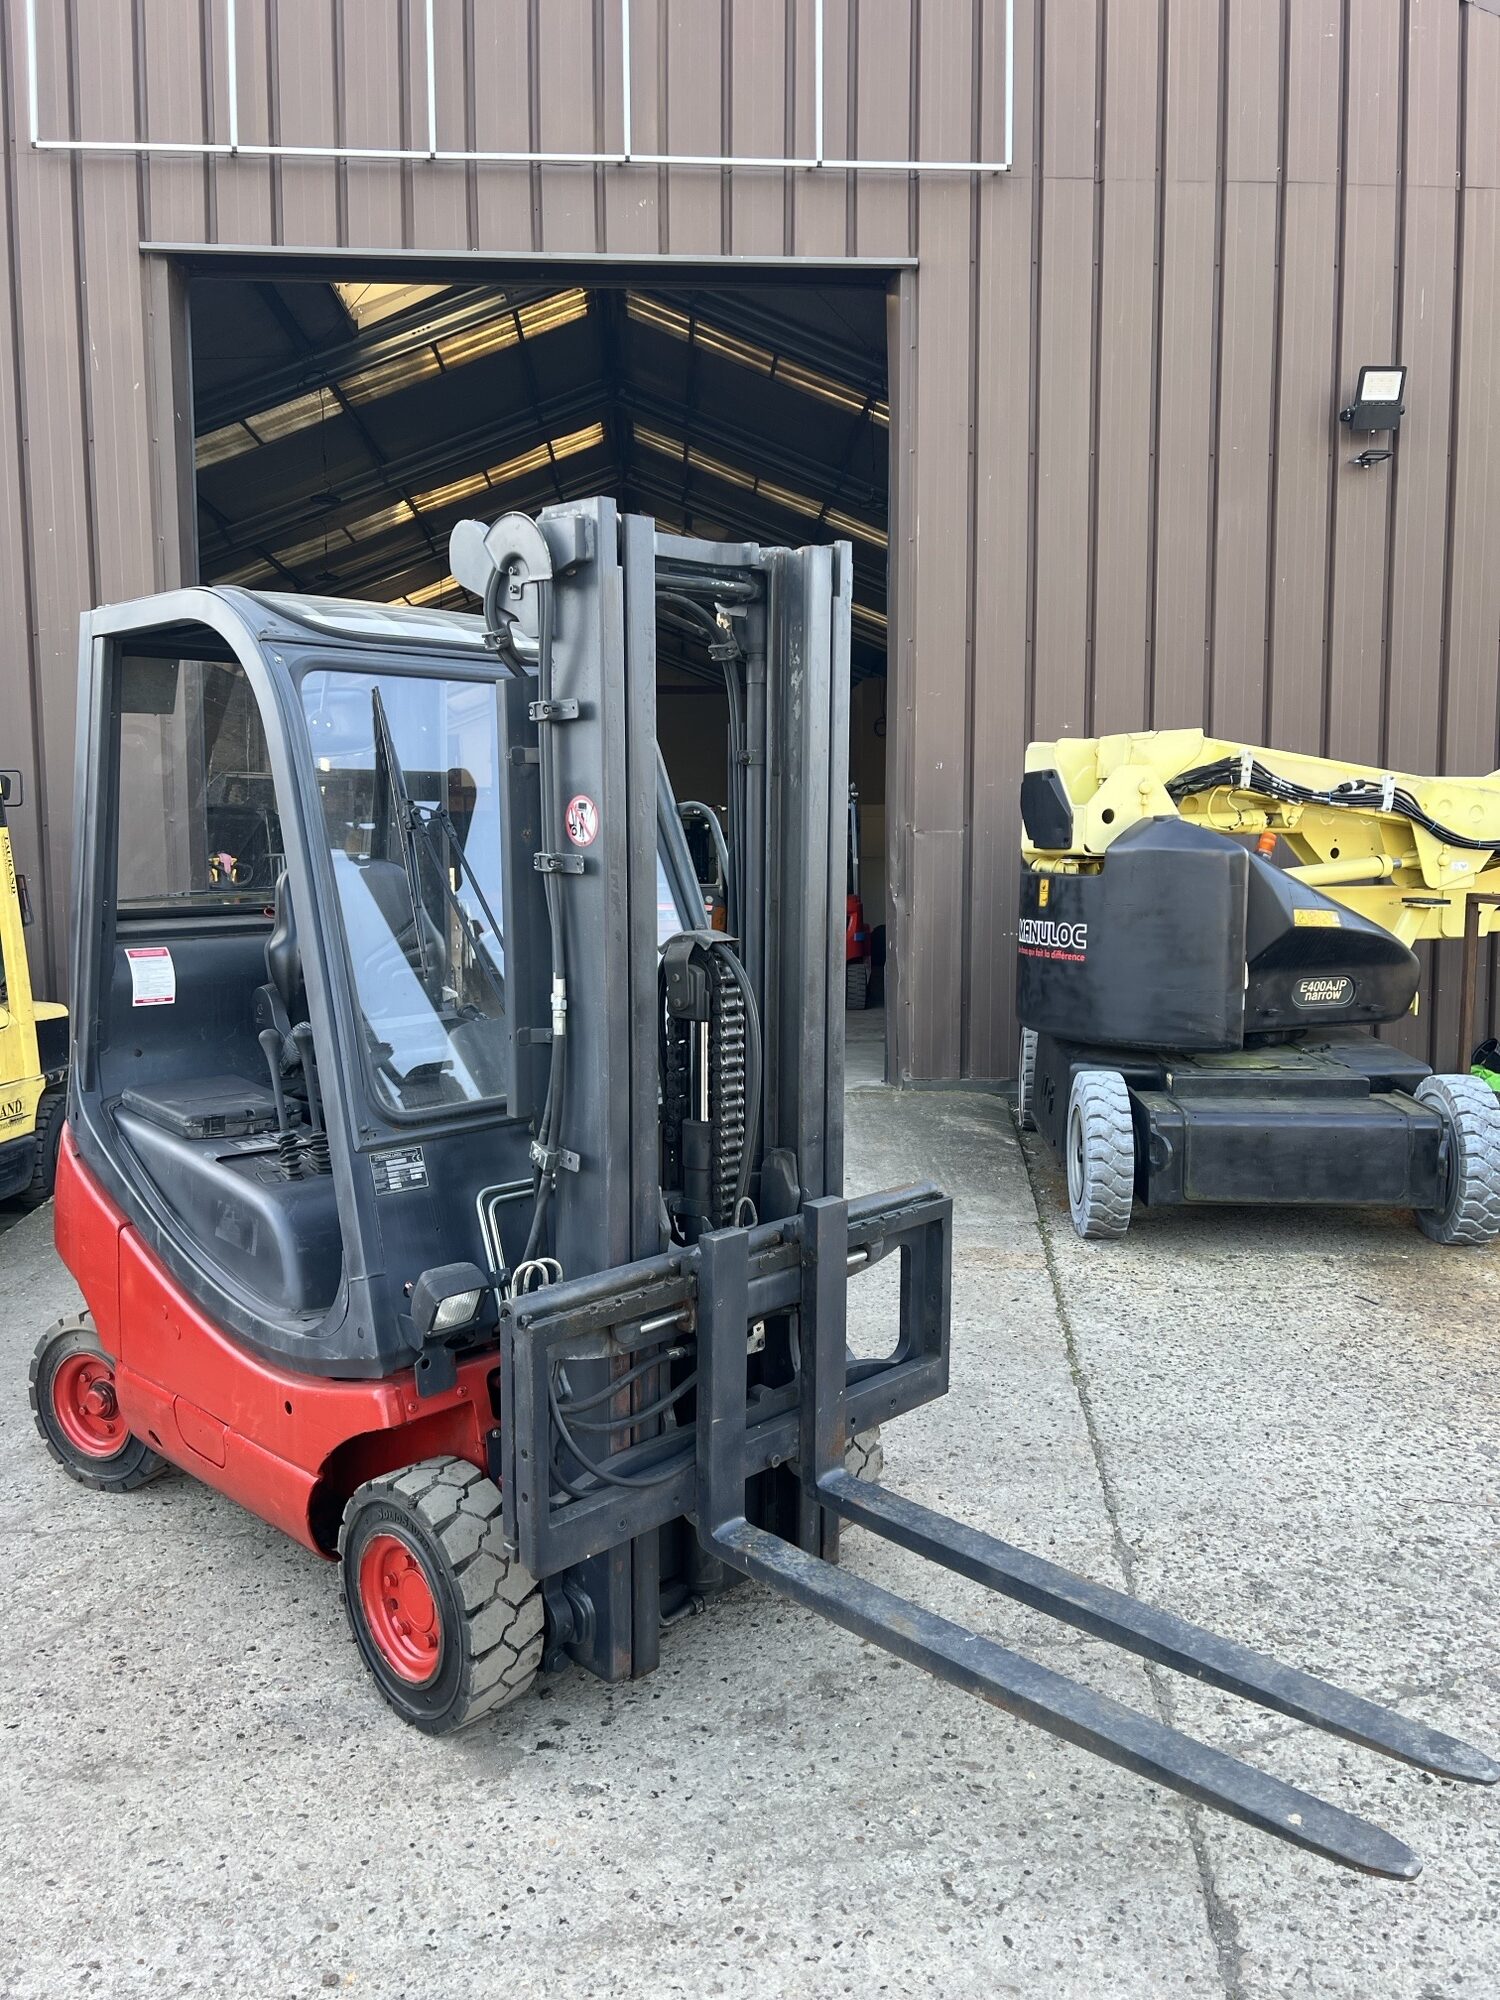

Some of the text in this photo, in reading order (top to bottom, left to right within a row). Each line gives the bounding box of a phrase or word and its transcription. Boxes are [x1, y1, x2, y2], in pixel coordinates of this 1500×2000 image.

[1018, 918, 1088, 950] MANULOC
[1300, 980, 1347, 993] E400AJP
[1304, 991, 1342, 1001] narrow
